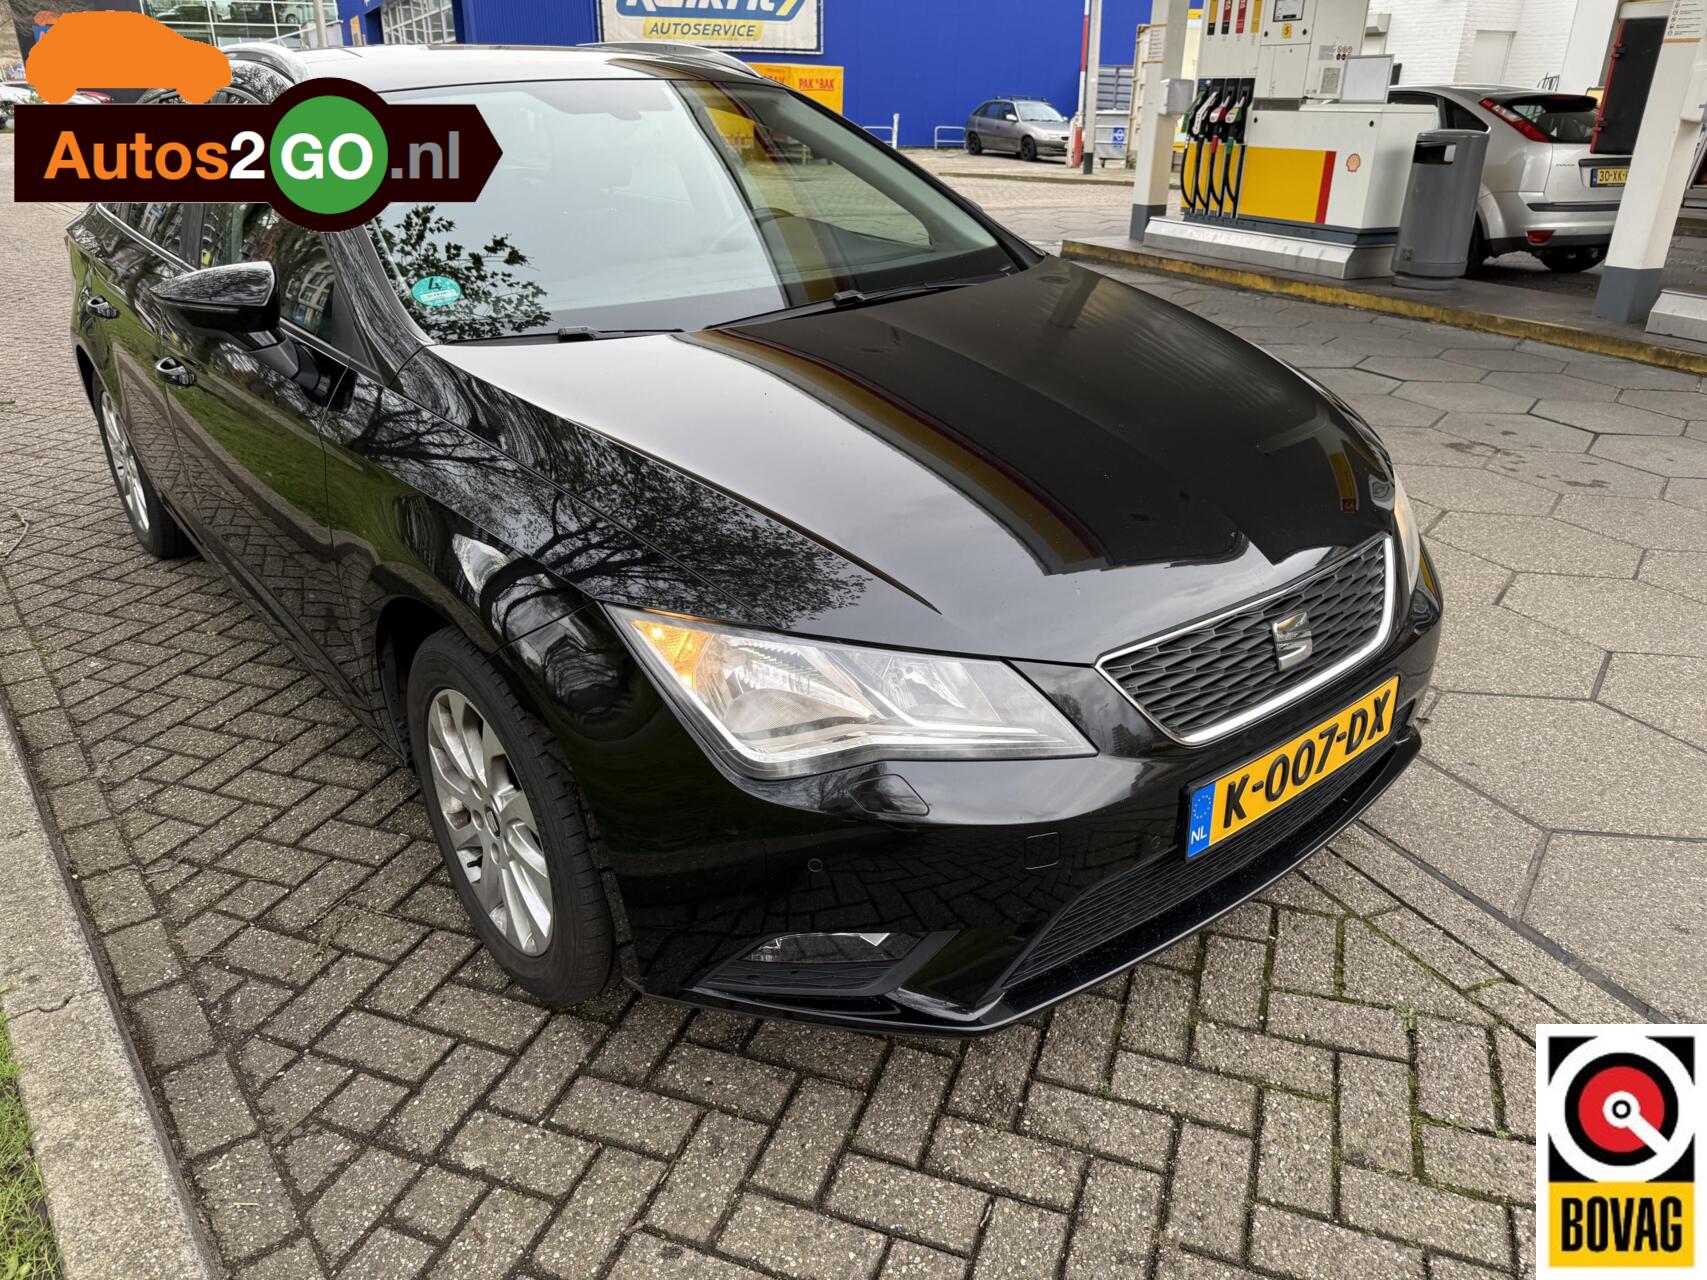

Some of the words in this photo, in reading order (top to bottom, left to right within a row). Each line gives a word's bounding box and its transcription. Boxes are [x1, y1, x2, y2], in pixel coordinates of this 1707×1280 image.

[649, 22, 756, 37] AUTOSERVICE
[1599, 169, 1628, 182] 30-XK-
[1223, 688, 1391, 829] K-007-DX
[1190, 825, 1207, 845] NL
